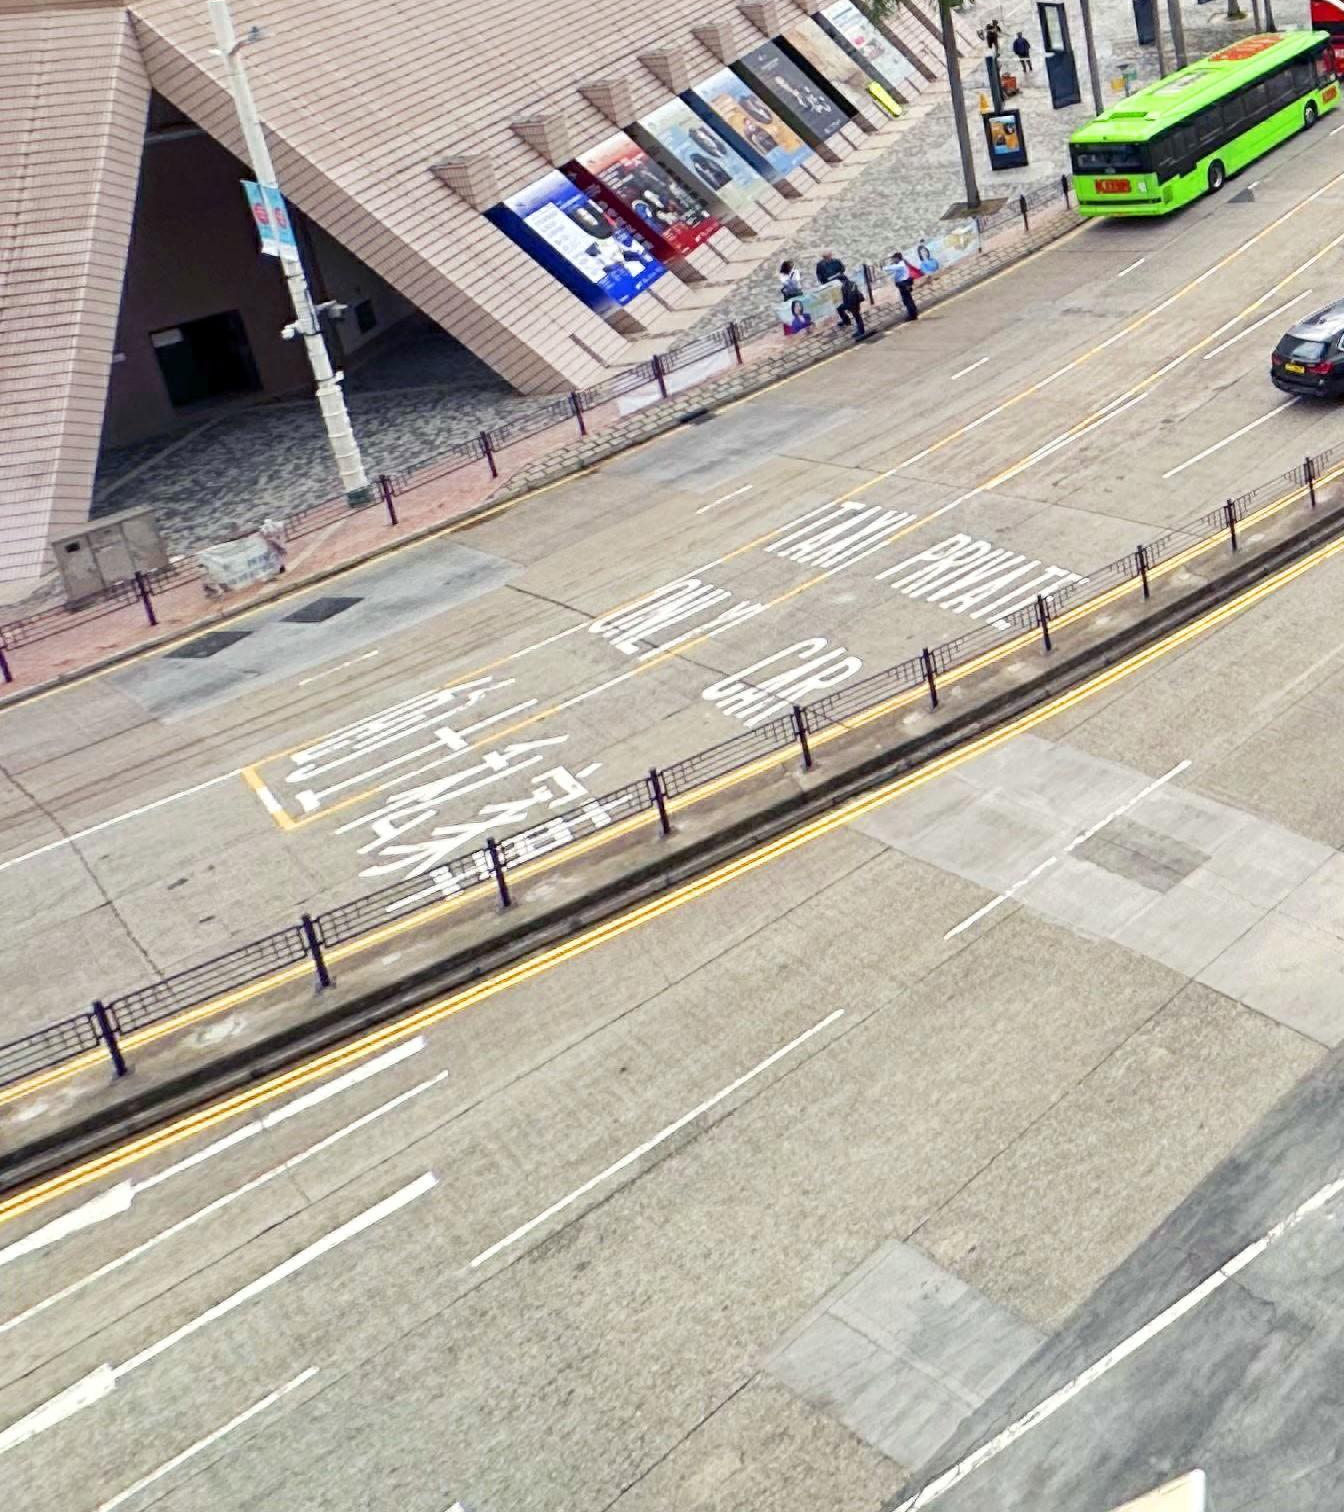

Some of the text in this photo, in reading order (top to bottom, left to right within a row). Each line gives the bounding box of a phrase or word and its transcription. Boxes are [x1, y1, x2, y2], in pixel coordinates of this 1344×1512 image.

[764, 500, 918, 569] TAXI
[589, 578, 764, 663] ONLY
[875, 532, 1090, 631] PRIVATE
[702, 636, 863, 728] CAR
